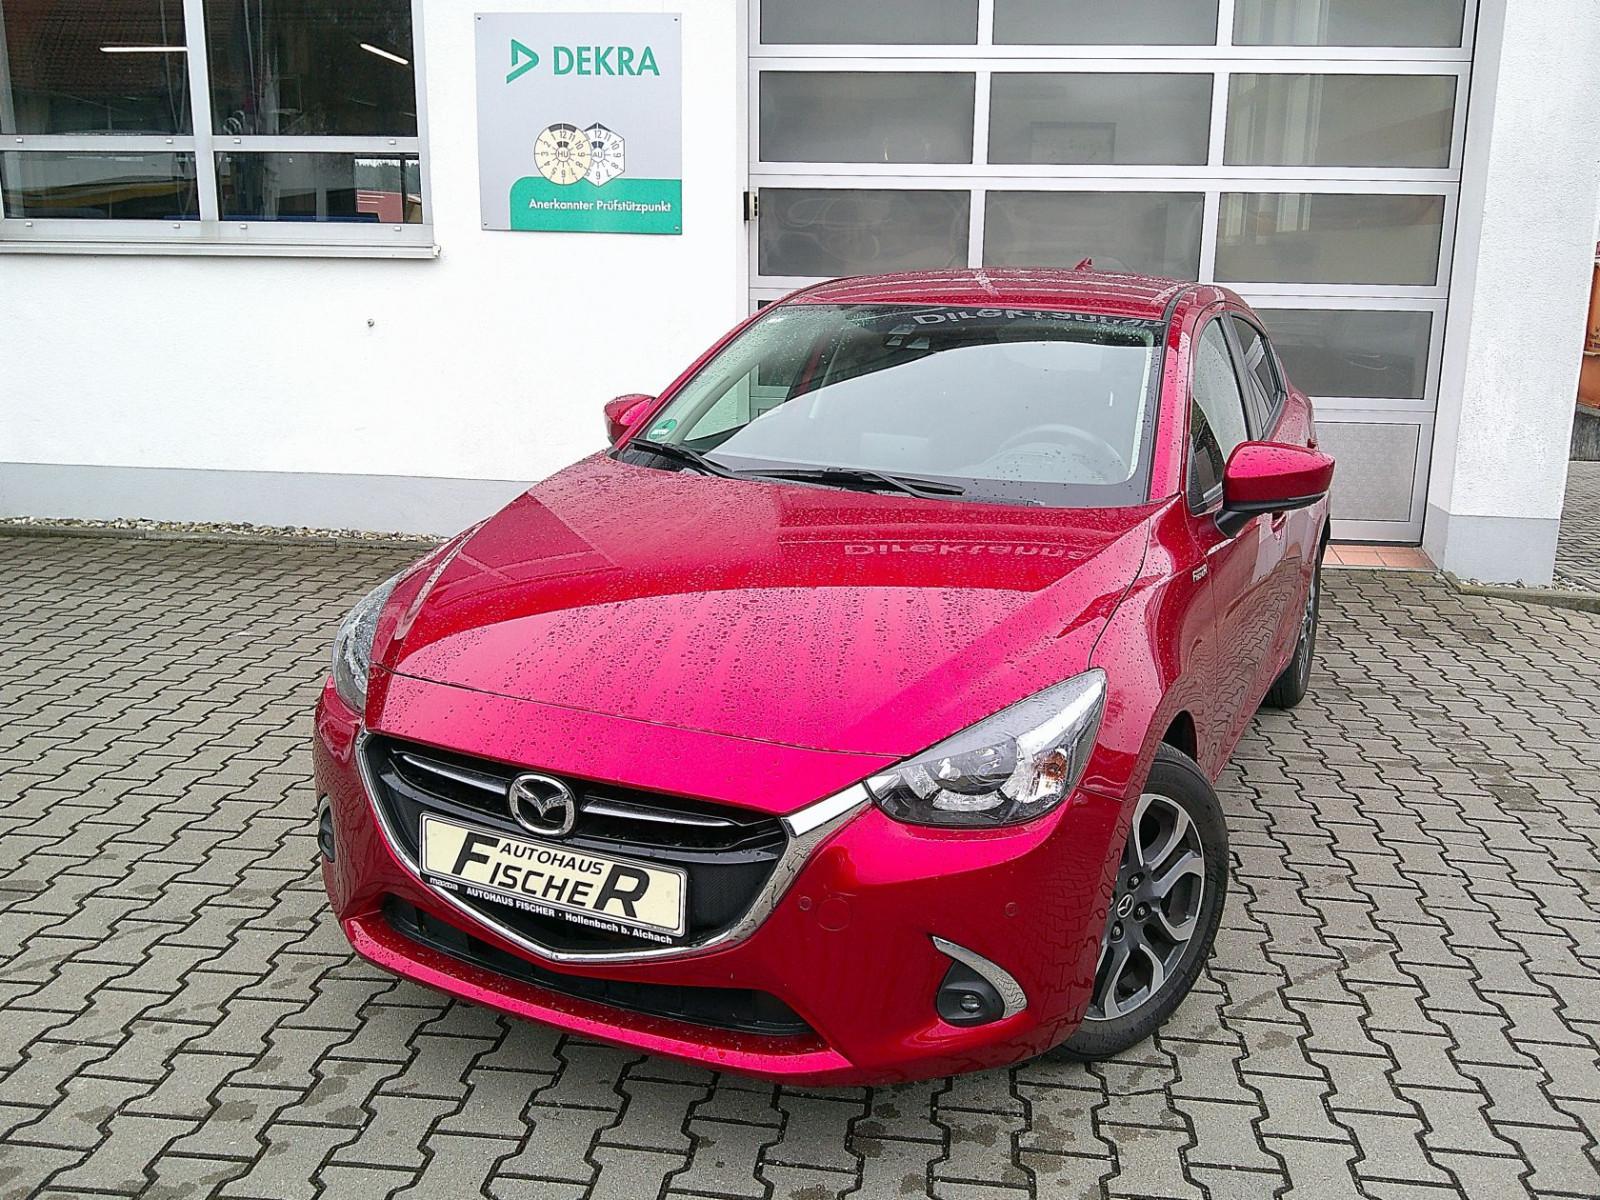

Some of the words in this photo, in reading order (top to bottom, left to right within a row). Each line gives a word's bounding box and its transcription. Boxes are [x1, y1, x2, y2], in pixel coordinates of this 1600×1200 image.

[553, 46, 660, 76] DEKRA
[560, 131, 567, 139] 12
[595, 130, 602, 139] 12
[557, 150, 569, 158] HU
[592, 150, 603, 158] AU
[528, 198, 594, 211] Anerkannter
[596, 200, 672, 213] Prüfstützpunkt
[500, 843, 605, 875] AUTOHAUS
[451, 831, 650, 918] FISCHER
[429, 877, 459, 891] mazda
[466, 886, 514, 906] AUTOHAUS
[515, 900, 555, 917] FISCHER
[565, 912, 619, 933] Hollenbach
[621, 925, 630, 935] b.
[632, 928, 673, 944] Aichach
